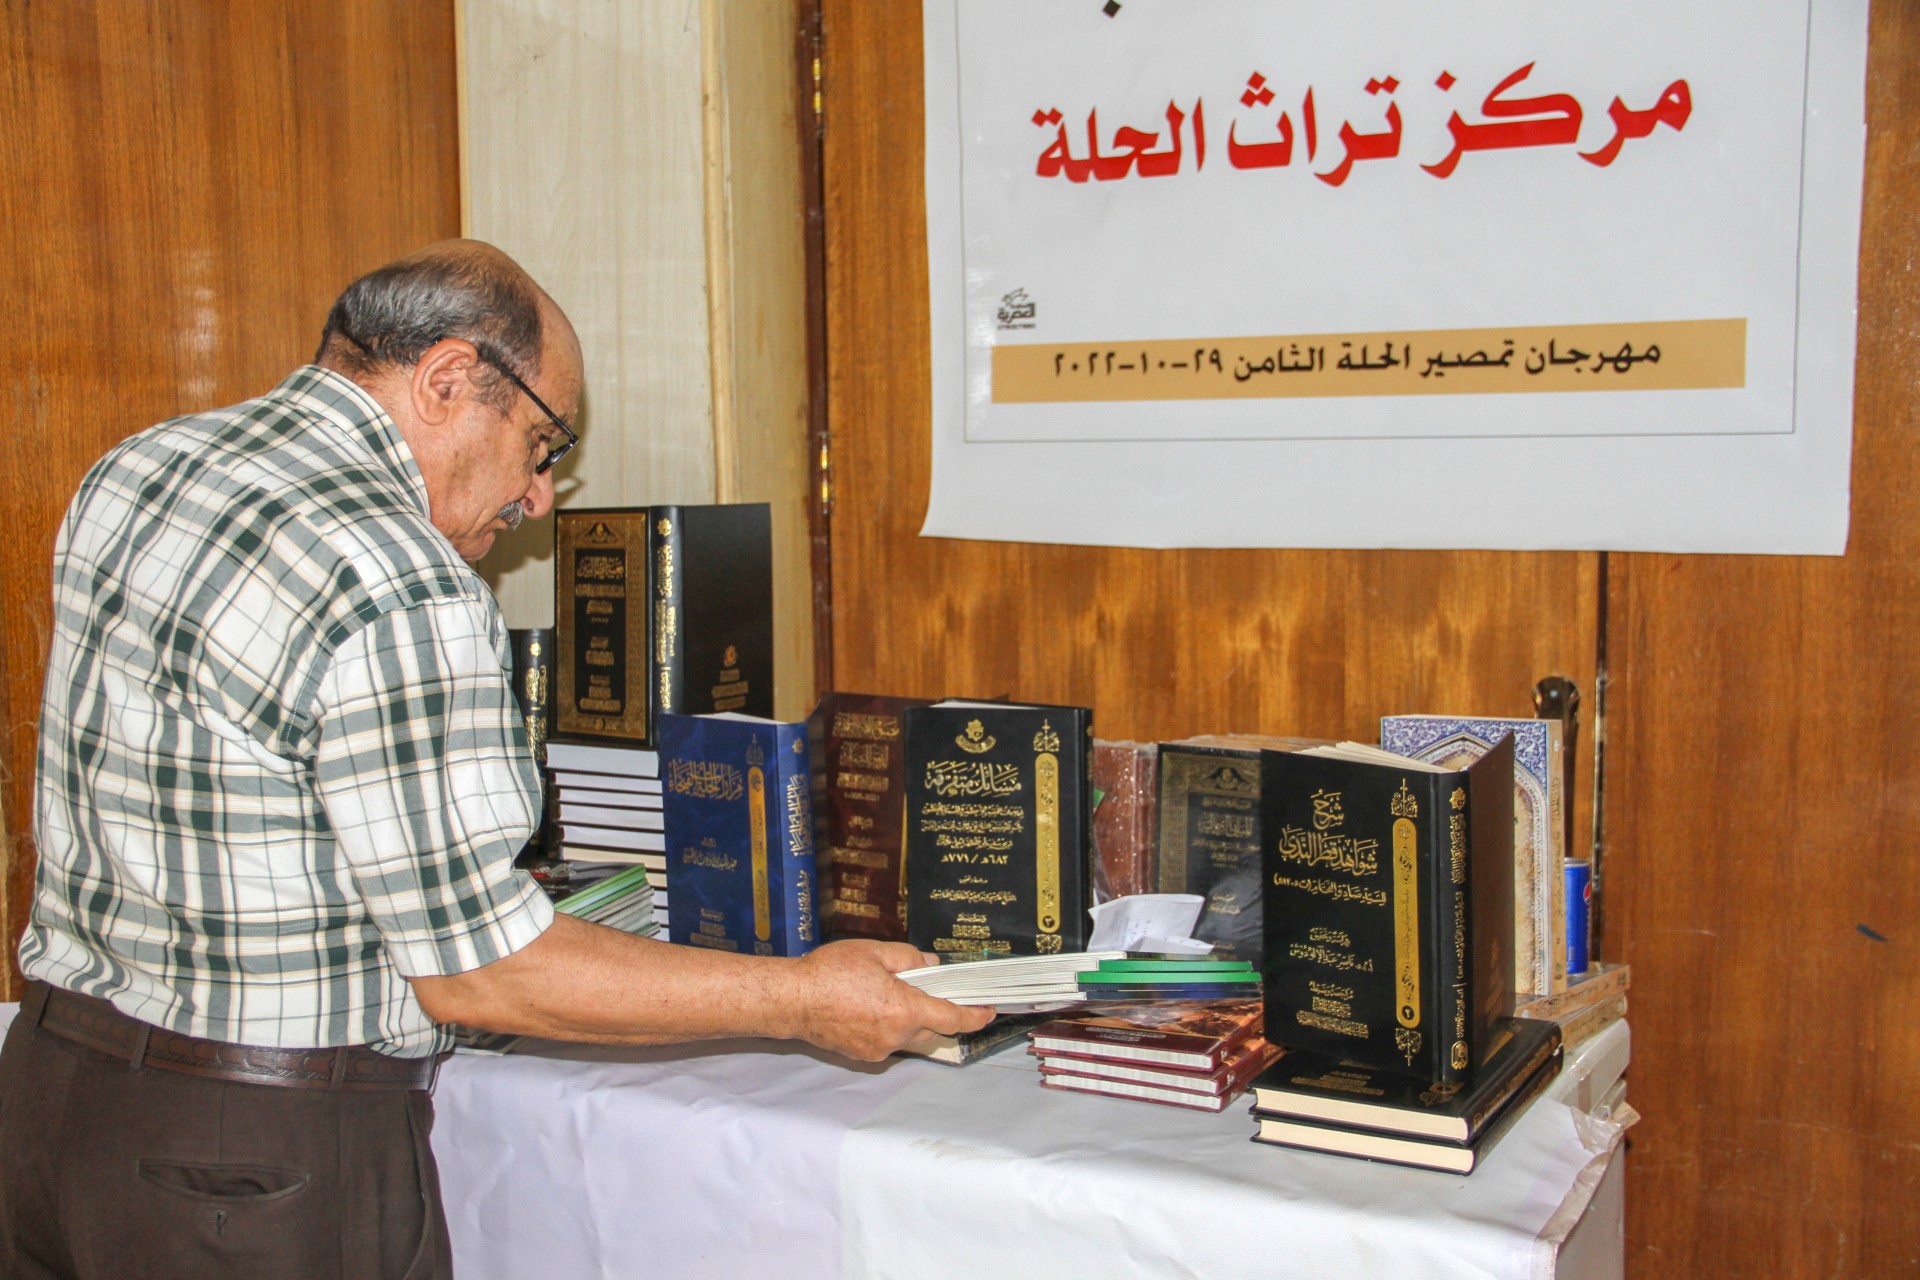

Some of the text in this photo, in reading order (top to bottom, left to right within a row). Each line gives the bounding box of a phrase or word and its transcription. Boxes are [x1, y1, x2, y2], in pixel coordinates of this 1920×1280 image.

[1031, 61, 1694, 188] مركز تراث الحلة
[1234, 343, 1325, 382] الثامن
[1337, 341, 1411, 371] الحلة
[1420, 338, 1515, 378] تمصير
[1525, 338, 1661, 376] مهرجان
[924, 760, 974, 797] متفرقة
[966, 762, 1022, 798] مسائل
